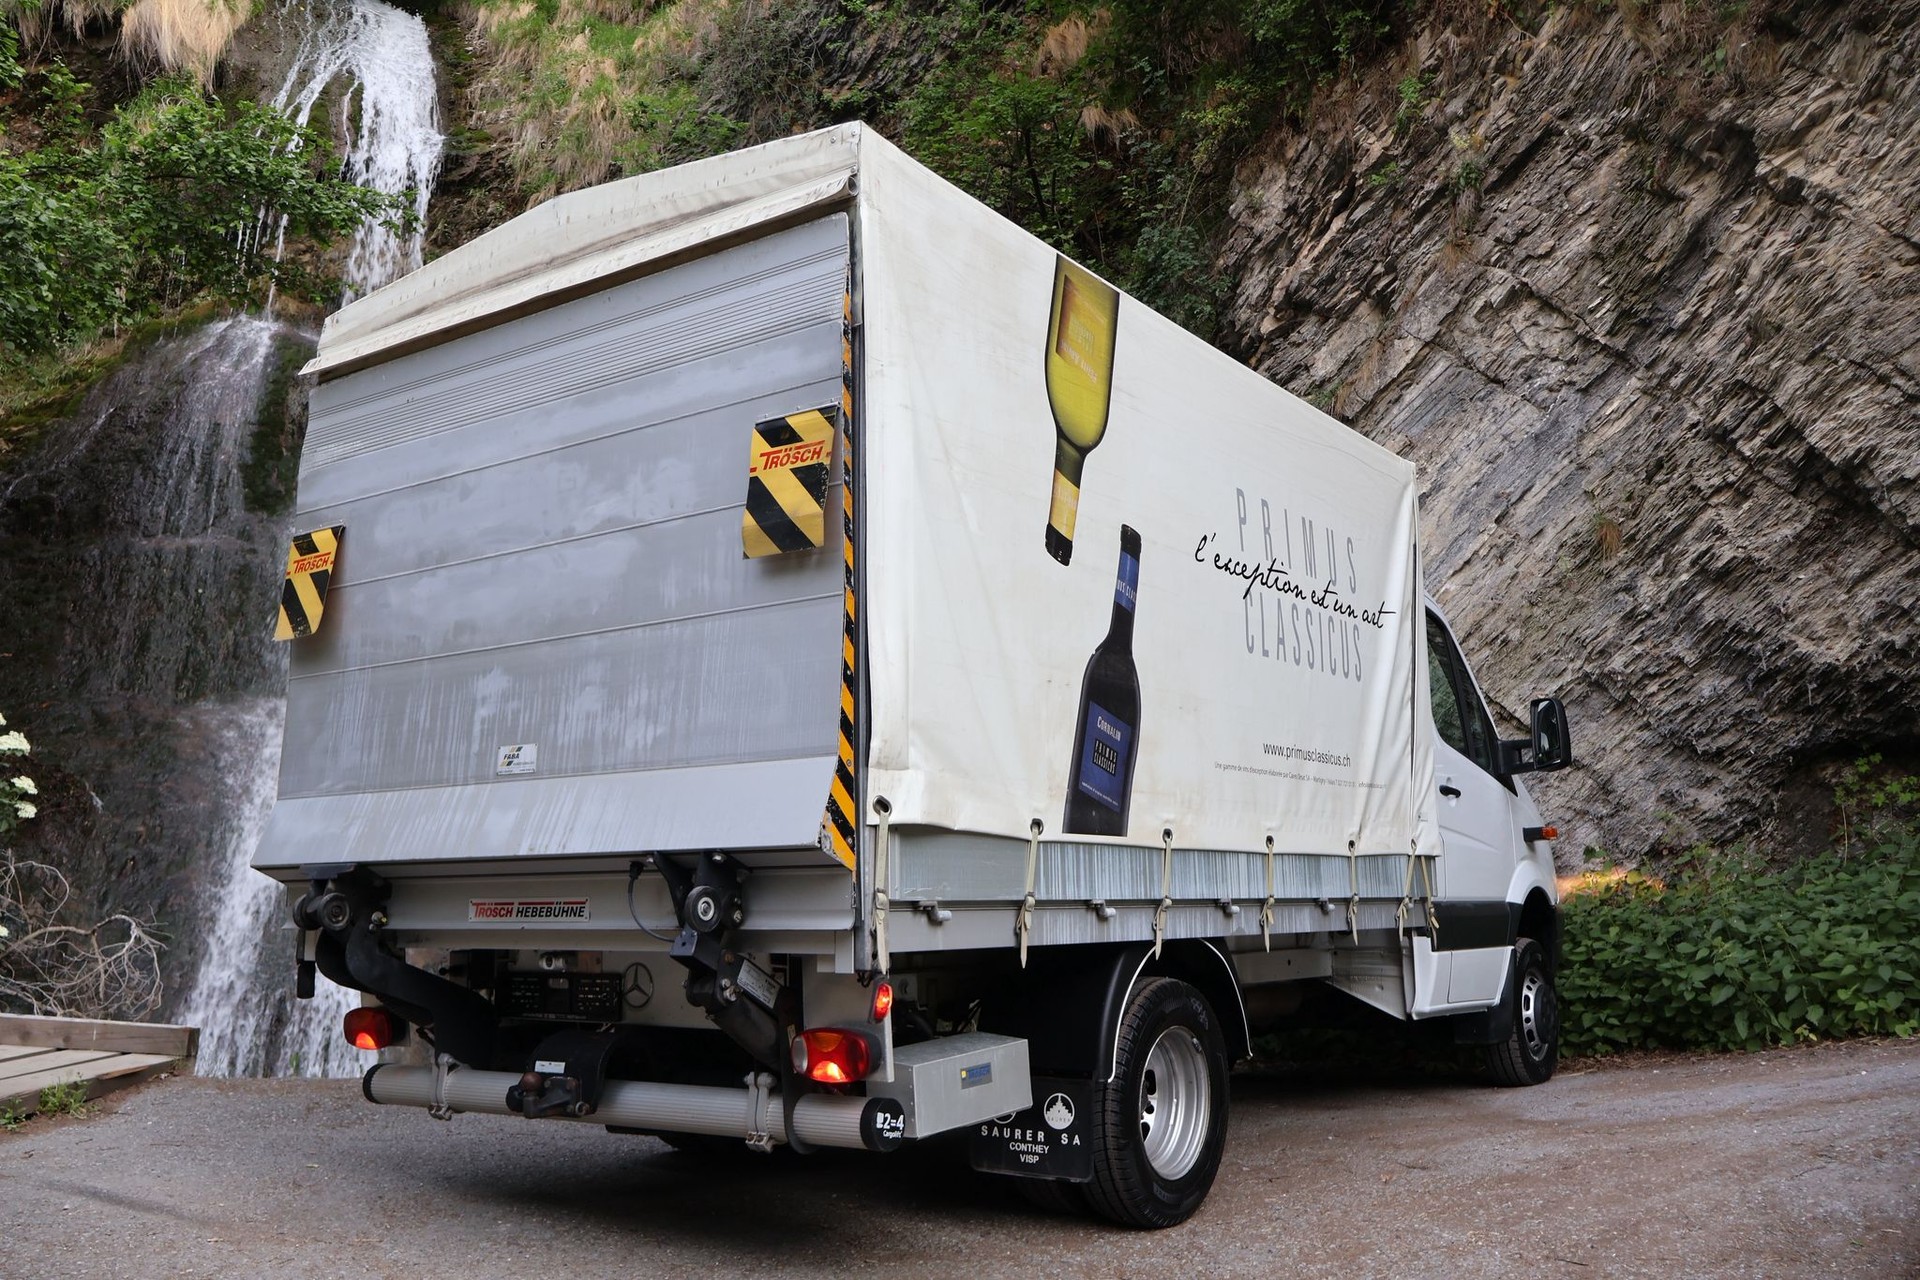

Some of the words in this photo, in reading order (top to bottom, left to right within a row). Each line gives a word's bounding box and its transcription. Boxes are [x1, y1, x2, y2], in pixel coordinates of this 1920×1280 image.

[760, 440, 825, 470] TRÖSCH
[1236, 487, 1356, 594] PRIMUS
[293, 552, 331, 574] TRÖSCH
[1310, 580, 1338, 610] est
[1333, 602, 1358, 619] un
[1362, 600, 1397, 629] art
[1244, 590, 1362, 683] CLASSICUS
[1263, 742, 1351, 767] www.primusclassicus.ch
[472, 902, 514, 918] TRÖSCH
[515, 901, 586, 918] HEBEBÜHNE
[981, 1125, 1045, 1142] SAURER
[1061, 1133, 1080, 1146] SA
[1009, 1141, 1049, 1154] CONTHEY
[1020, 1154, 1039, 1164] VISP
